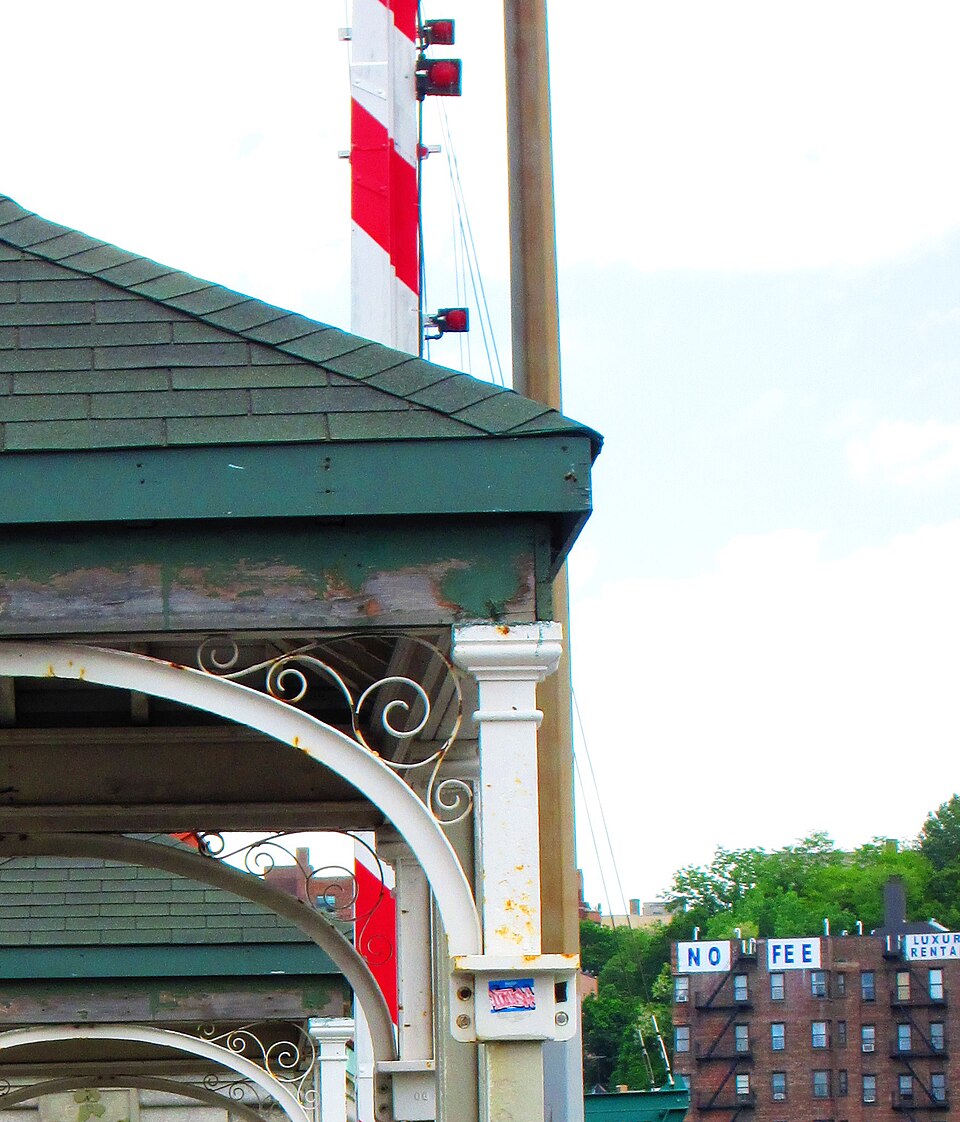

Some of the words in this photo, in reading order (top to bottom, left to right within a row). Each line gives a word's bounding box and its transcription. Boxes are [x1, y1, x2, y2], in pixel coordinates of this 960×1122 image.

[688, 946, 721, 966] NO
[772, 943, 812, 964] FEE
[911, 946, 957, 957] RENTA
